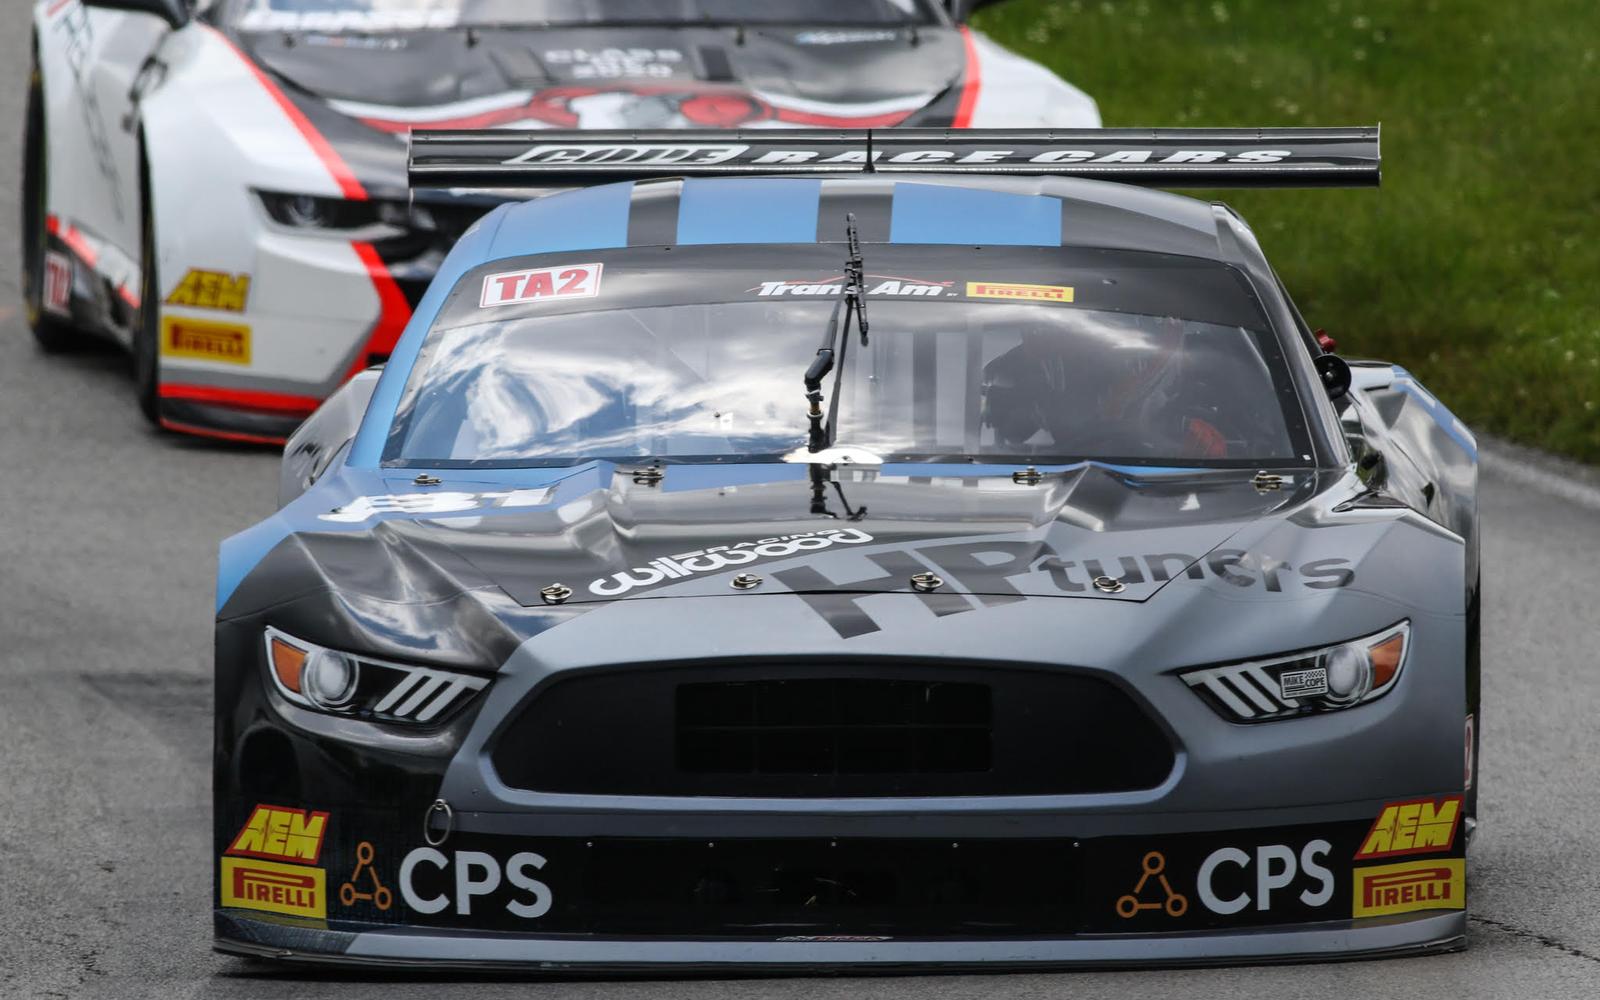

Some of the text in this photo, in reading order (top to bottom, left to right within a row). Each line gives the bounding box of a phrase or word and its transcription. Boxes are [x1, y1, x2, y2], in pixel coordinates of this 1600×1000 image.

[752, 150, 1014, 163] RACE
[1028, 150, 1292, 163] CARS
[165, 267, 251, 312] AEM
[496, 269, 588, 300] TA2
[868, 281, 943, 296] Am
[976, 284, 1064, 299] PIRELLI
[171, 324, 244, 358] PIRELLI
[588, 528, 874, 595] wilwood
[705, 529, 843, 553] RACING
[1284, 675, 1325, 687] MIKE COPE
[233, 807, 325, 864] AEM
[1358, 799, 1461, 855] AEM
[232, 867, 316, 909] PIRELLI
[399, 846, 553, 919] CPS
[1197, 839, 1334, 915] CPS
[1363, 867, 1453, 908] PIRELLI
